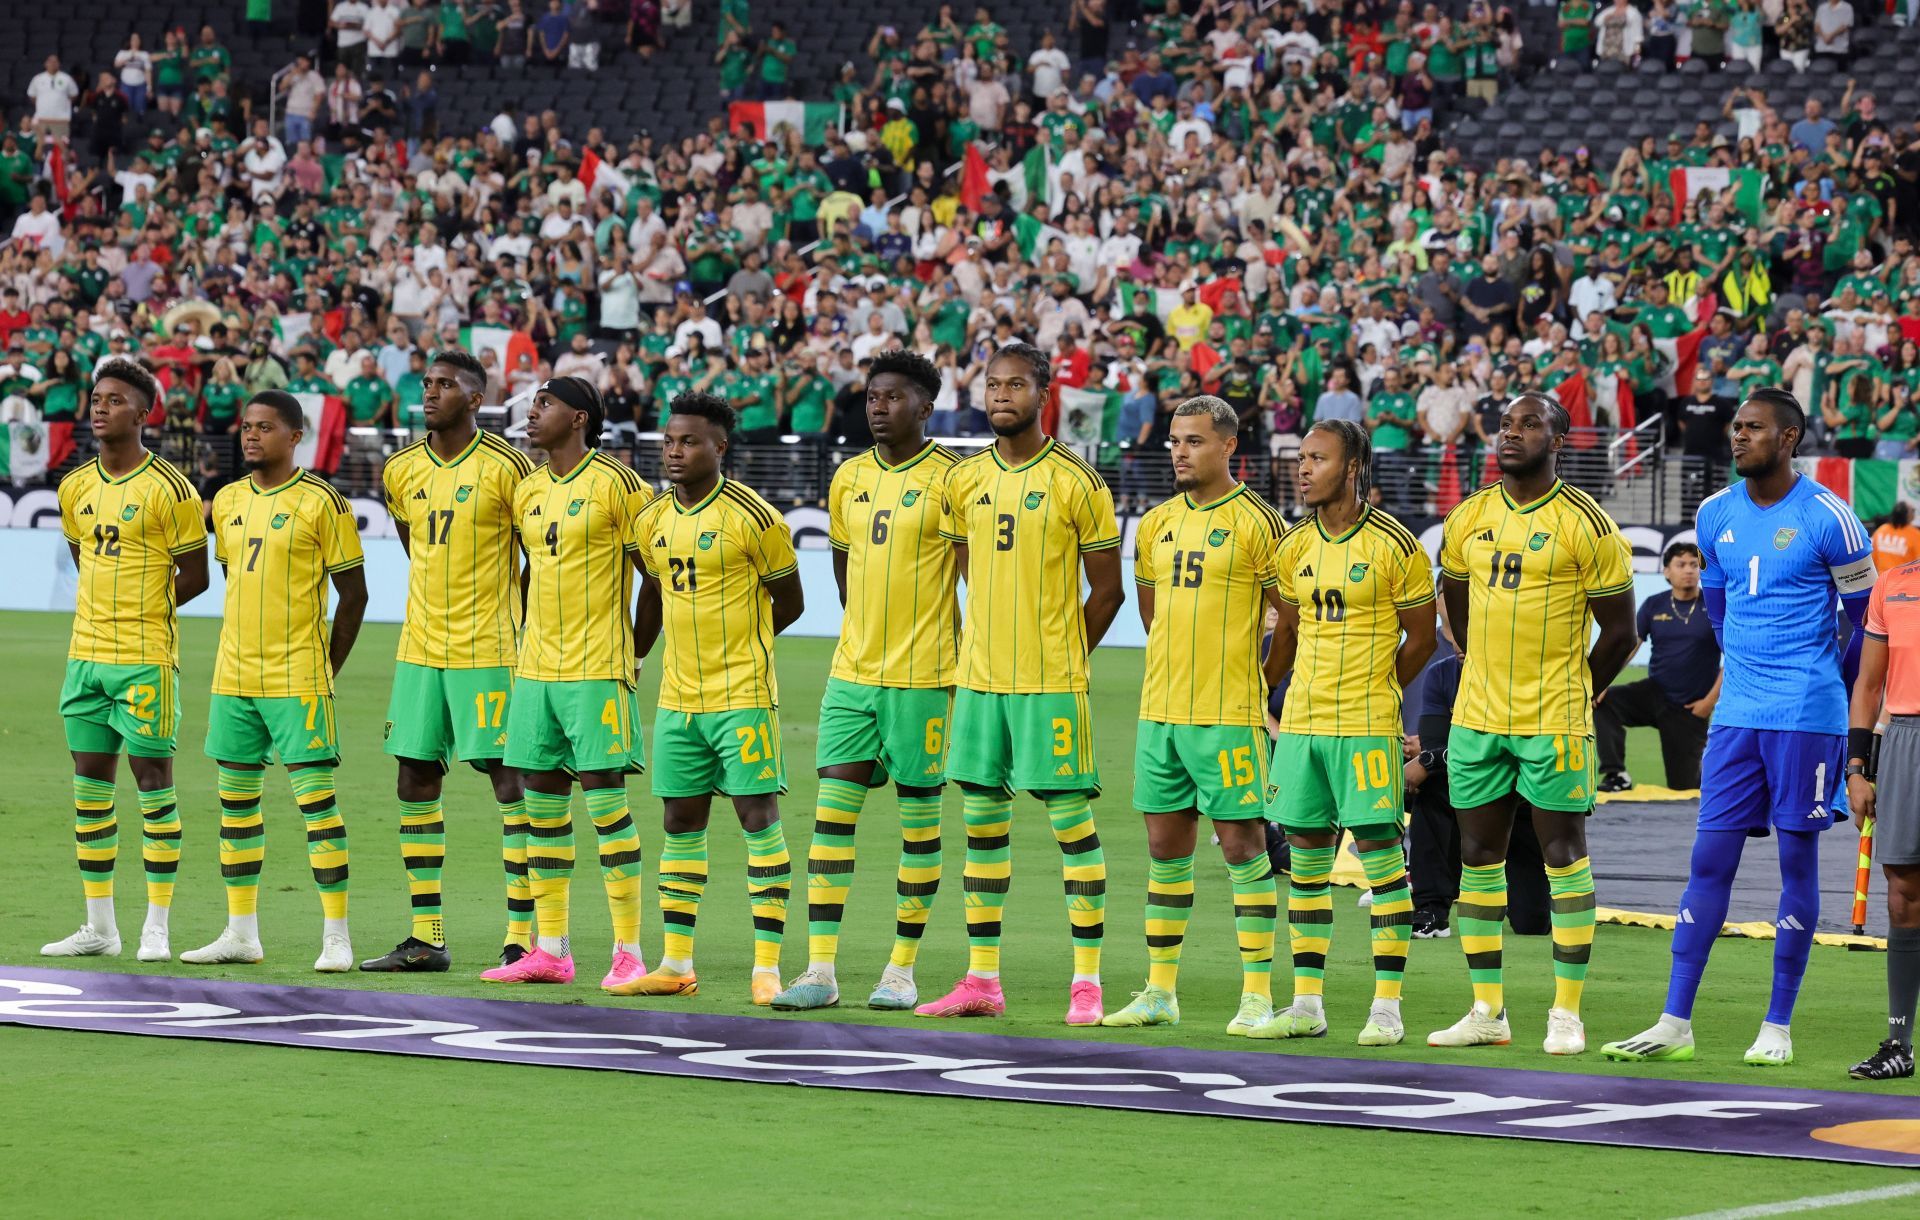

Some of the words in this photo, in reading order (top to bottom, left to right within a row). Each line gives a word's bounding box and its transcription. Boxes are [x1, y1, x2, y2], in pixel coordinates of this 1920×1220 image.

[94, 524, 121, 557] 12
[428, 509, 454, 545] 17
[545, 521, 558, 556] 4
[871, 509, 892, 545] 6
[996, 513, 1015, 551] 3
[247, 537, 264, 572] 7
[1172, 550, 1206, 589] 15
[1488, 551, 1523, 589] 18
[669, 557, 697, 592] 21
[1748, 555, 1760, 596] 1
[1311, 588, 1345, 622] 10
[127, 685, 156, 719] 12
[300, 695, 318, 730] 7
[475, 690, 507, 728] 17
[601, 699, 621, 735] 4
[736, 723, 773, 764] 21
[925, 718, 943, 755] 6
[1053, 718, 1073, 756] 3
[1553, 735, 1585, 772] 18
[1218, 746, 1255, 788] 15
[1352, 749, 1390, 791] 10
[1814, 762, 1826, 802] 1
